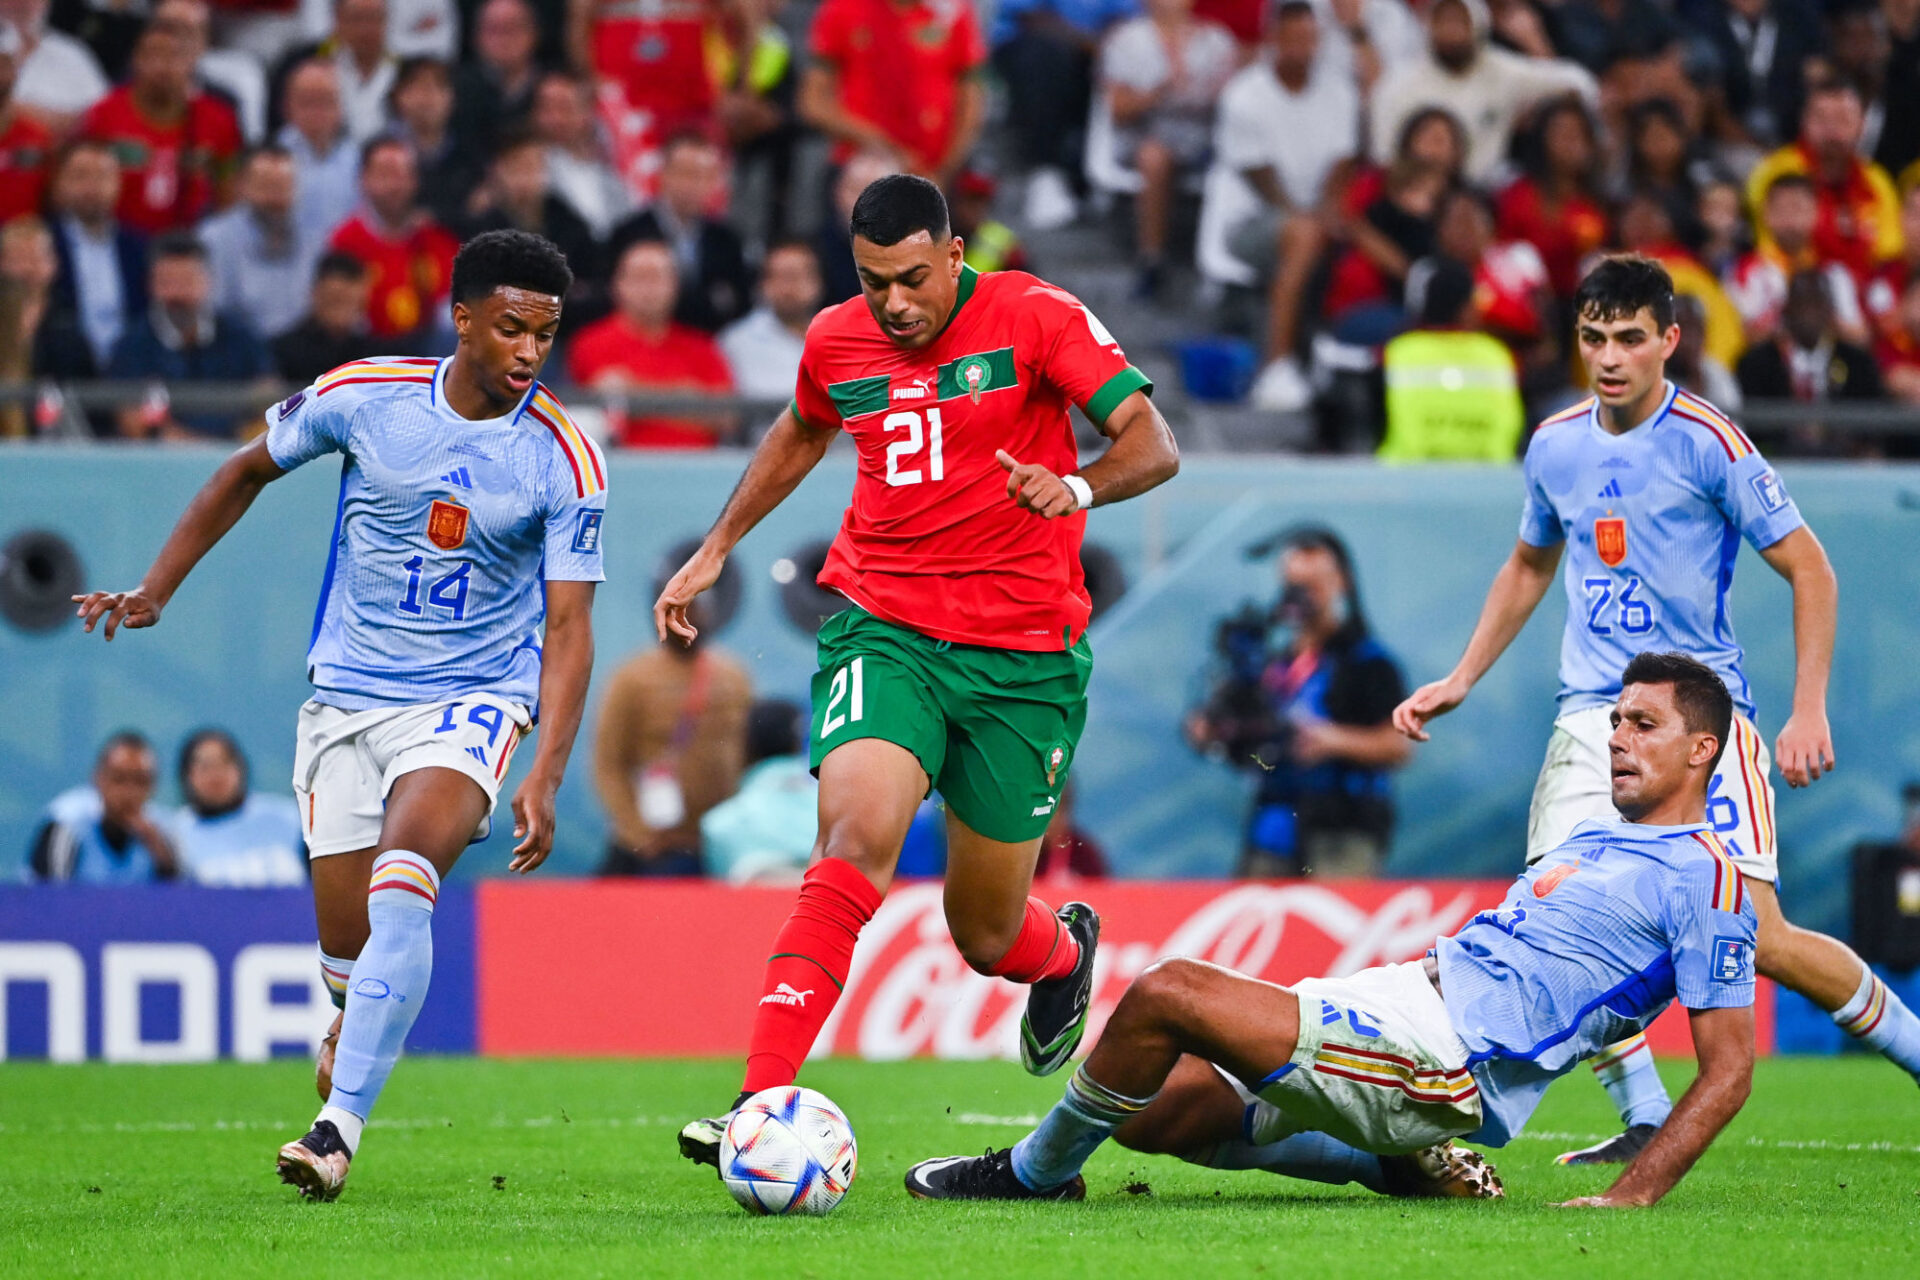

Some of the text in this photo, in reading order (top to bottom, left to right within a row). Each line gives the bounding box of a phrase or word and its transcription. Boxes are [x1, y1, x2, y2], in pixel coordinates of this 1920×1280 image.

[893, 388, 925, 400] PUMA
[883, 407, 944, 487] 21
[399, 555, 474, 621] 14
[1583, 575, 1655, 638] 26
[820, 656, 863, 739] 21
